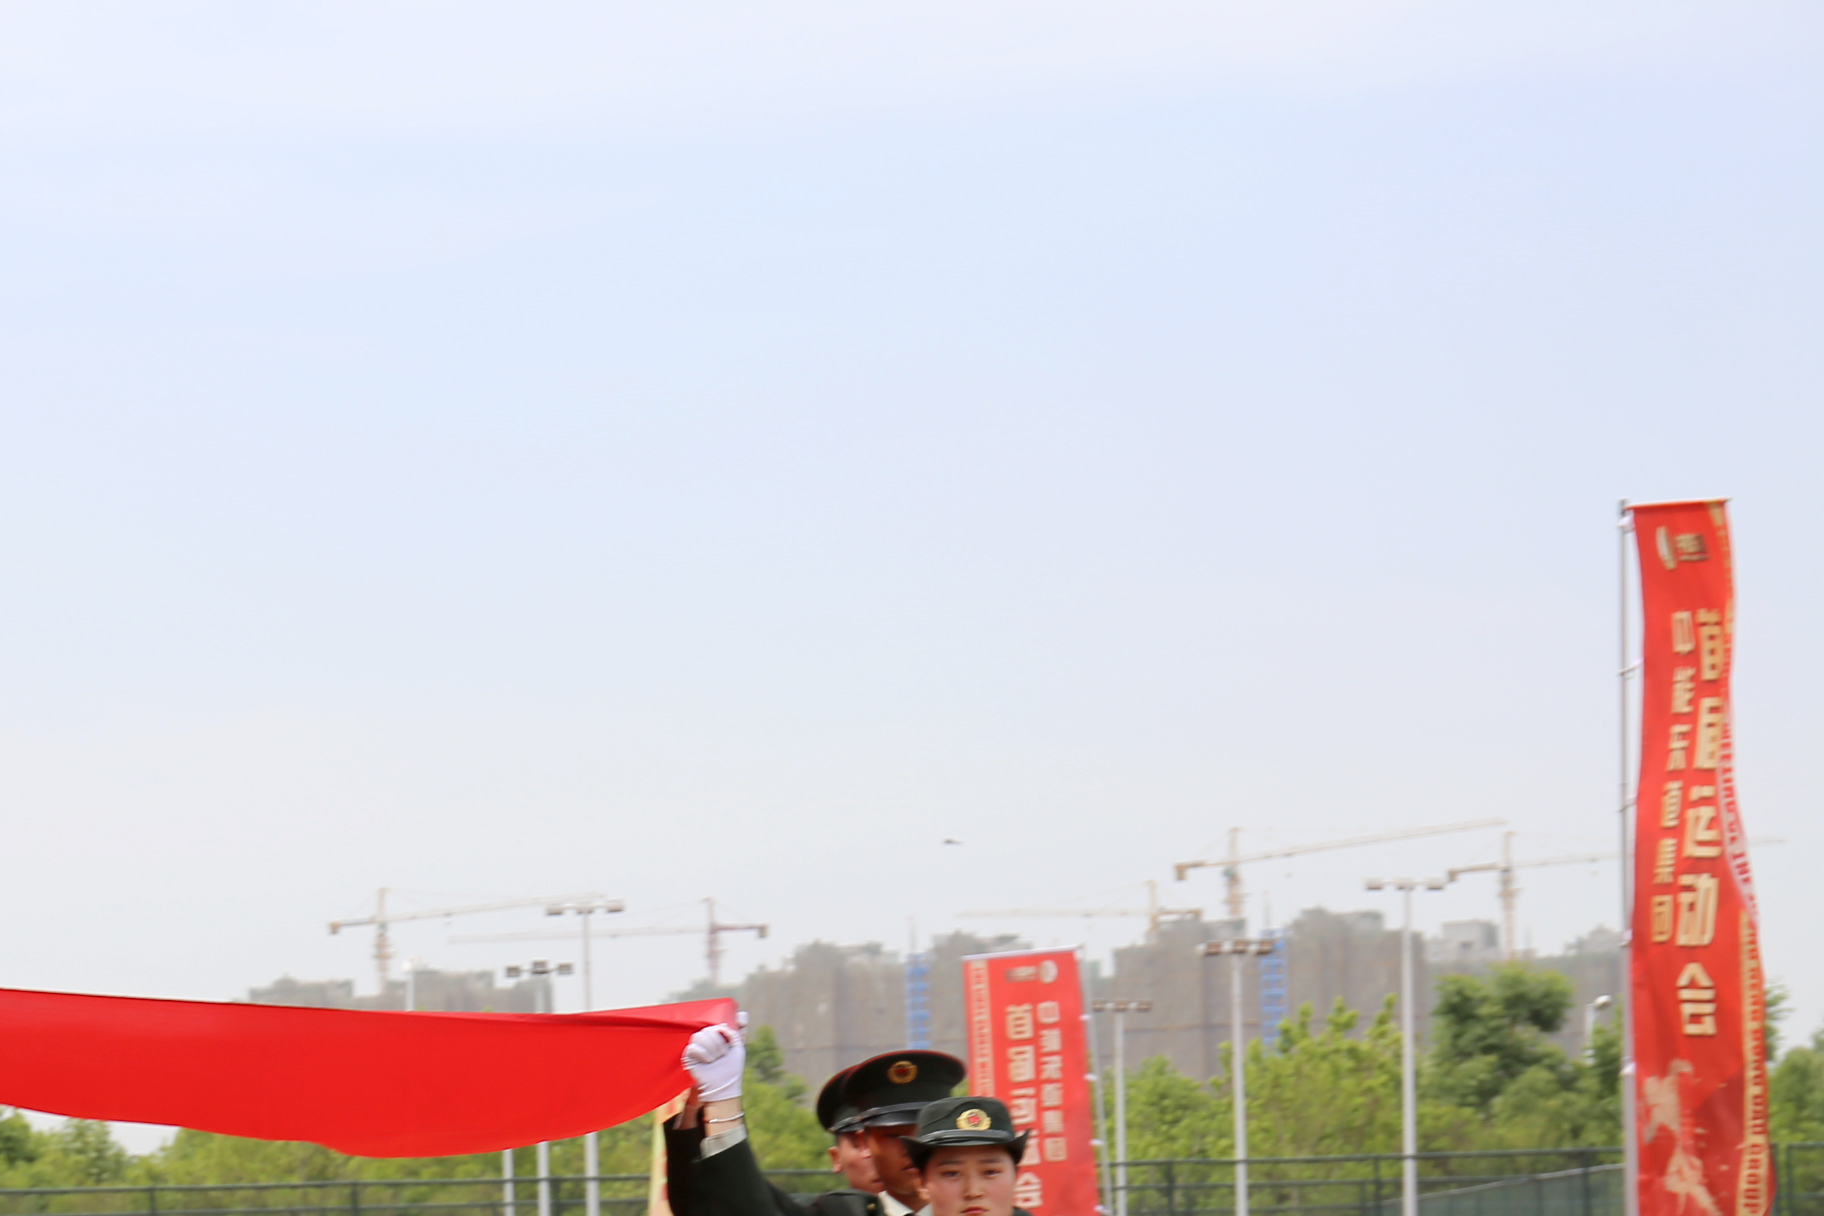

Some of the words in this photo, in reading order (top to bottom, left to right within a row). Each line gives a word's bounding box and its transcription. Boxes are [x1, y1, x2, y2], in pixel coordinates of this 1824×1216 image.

[1677, 607, 1723, 1036] 首届运动会
